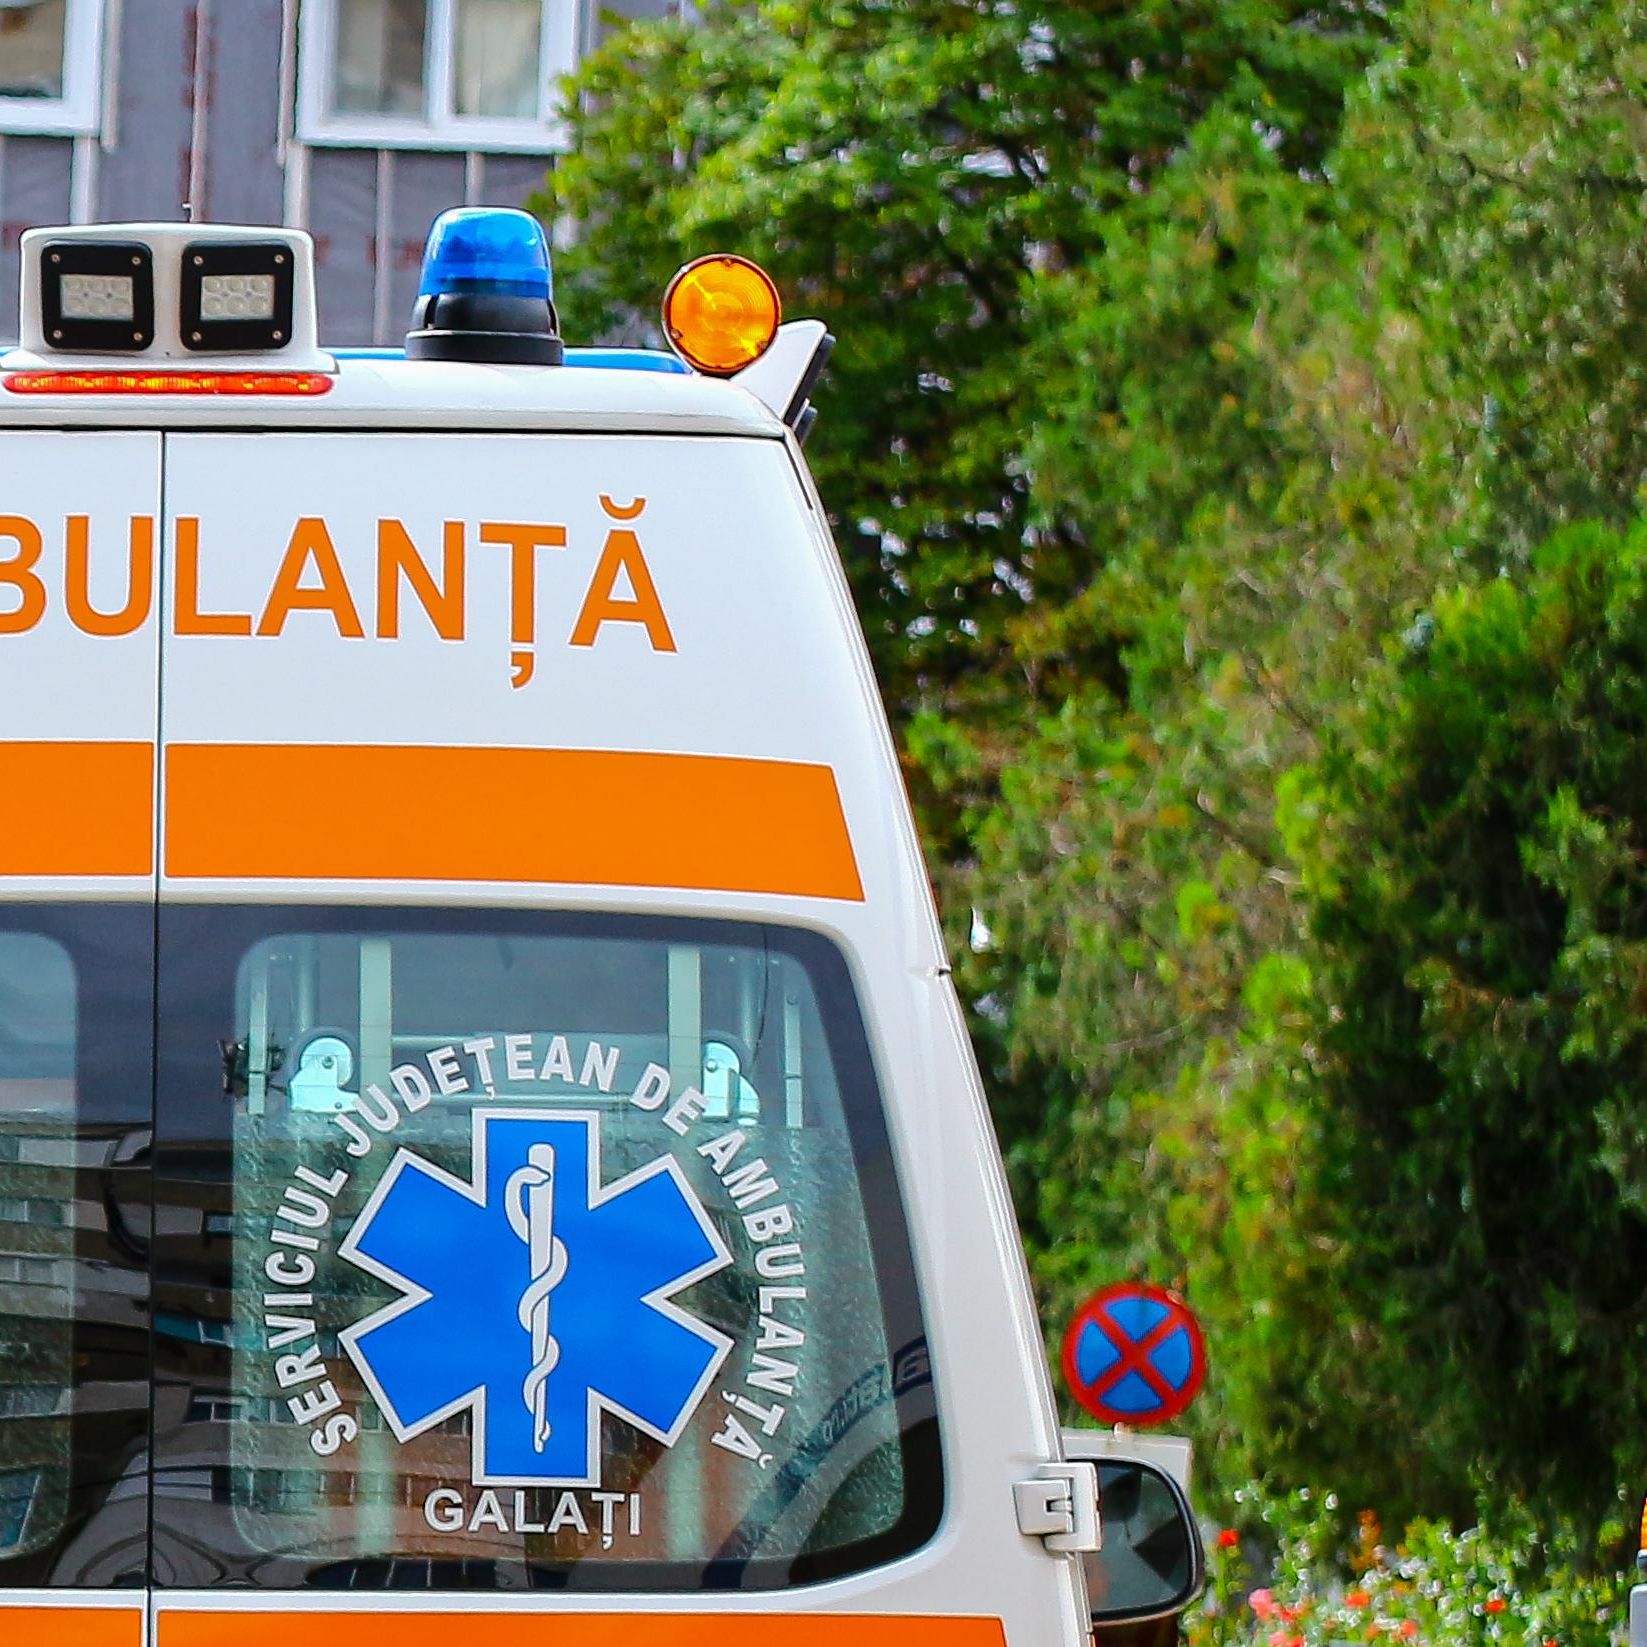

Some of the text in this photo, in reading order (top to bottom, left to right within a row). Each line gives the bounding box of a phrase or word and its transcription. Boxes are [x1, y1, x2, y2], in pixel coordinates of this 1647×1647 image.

[263, 1034, 807, 1470] SERVICIUL JUDEȚEAN DE AMBULANȚĂ
[423, 1488, 642, 1551] GALAȚI
